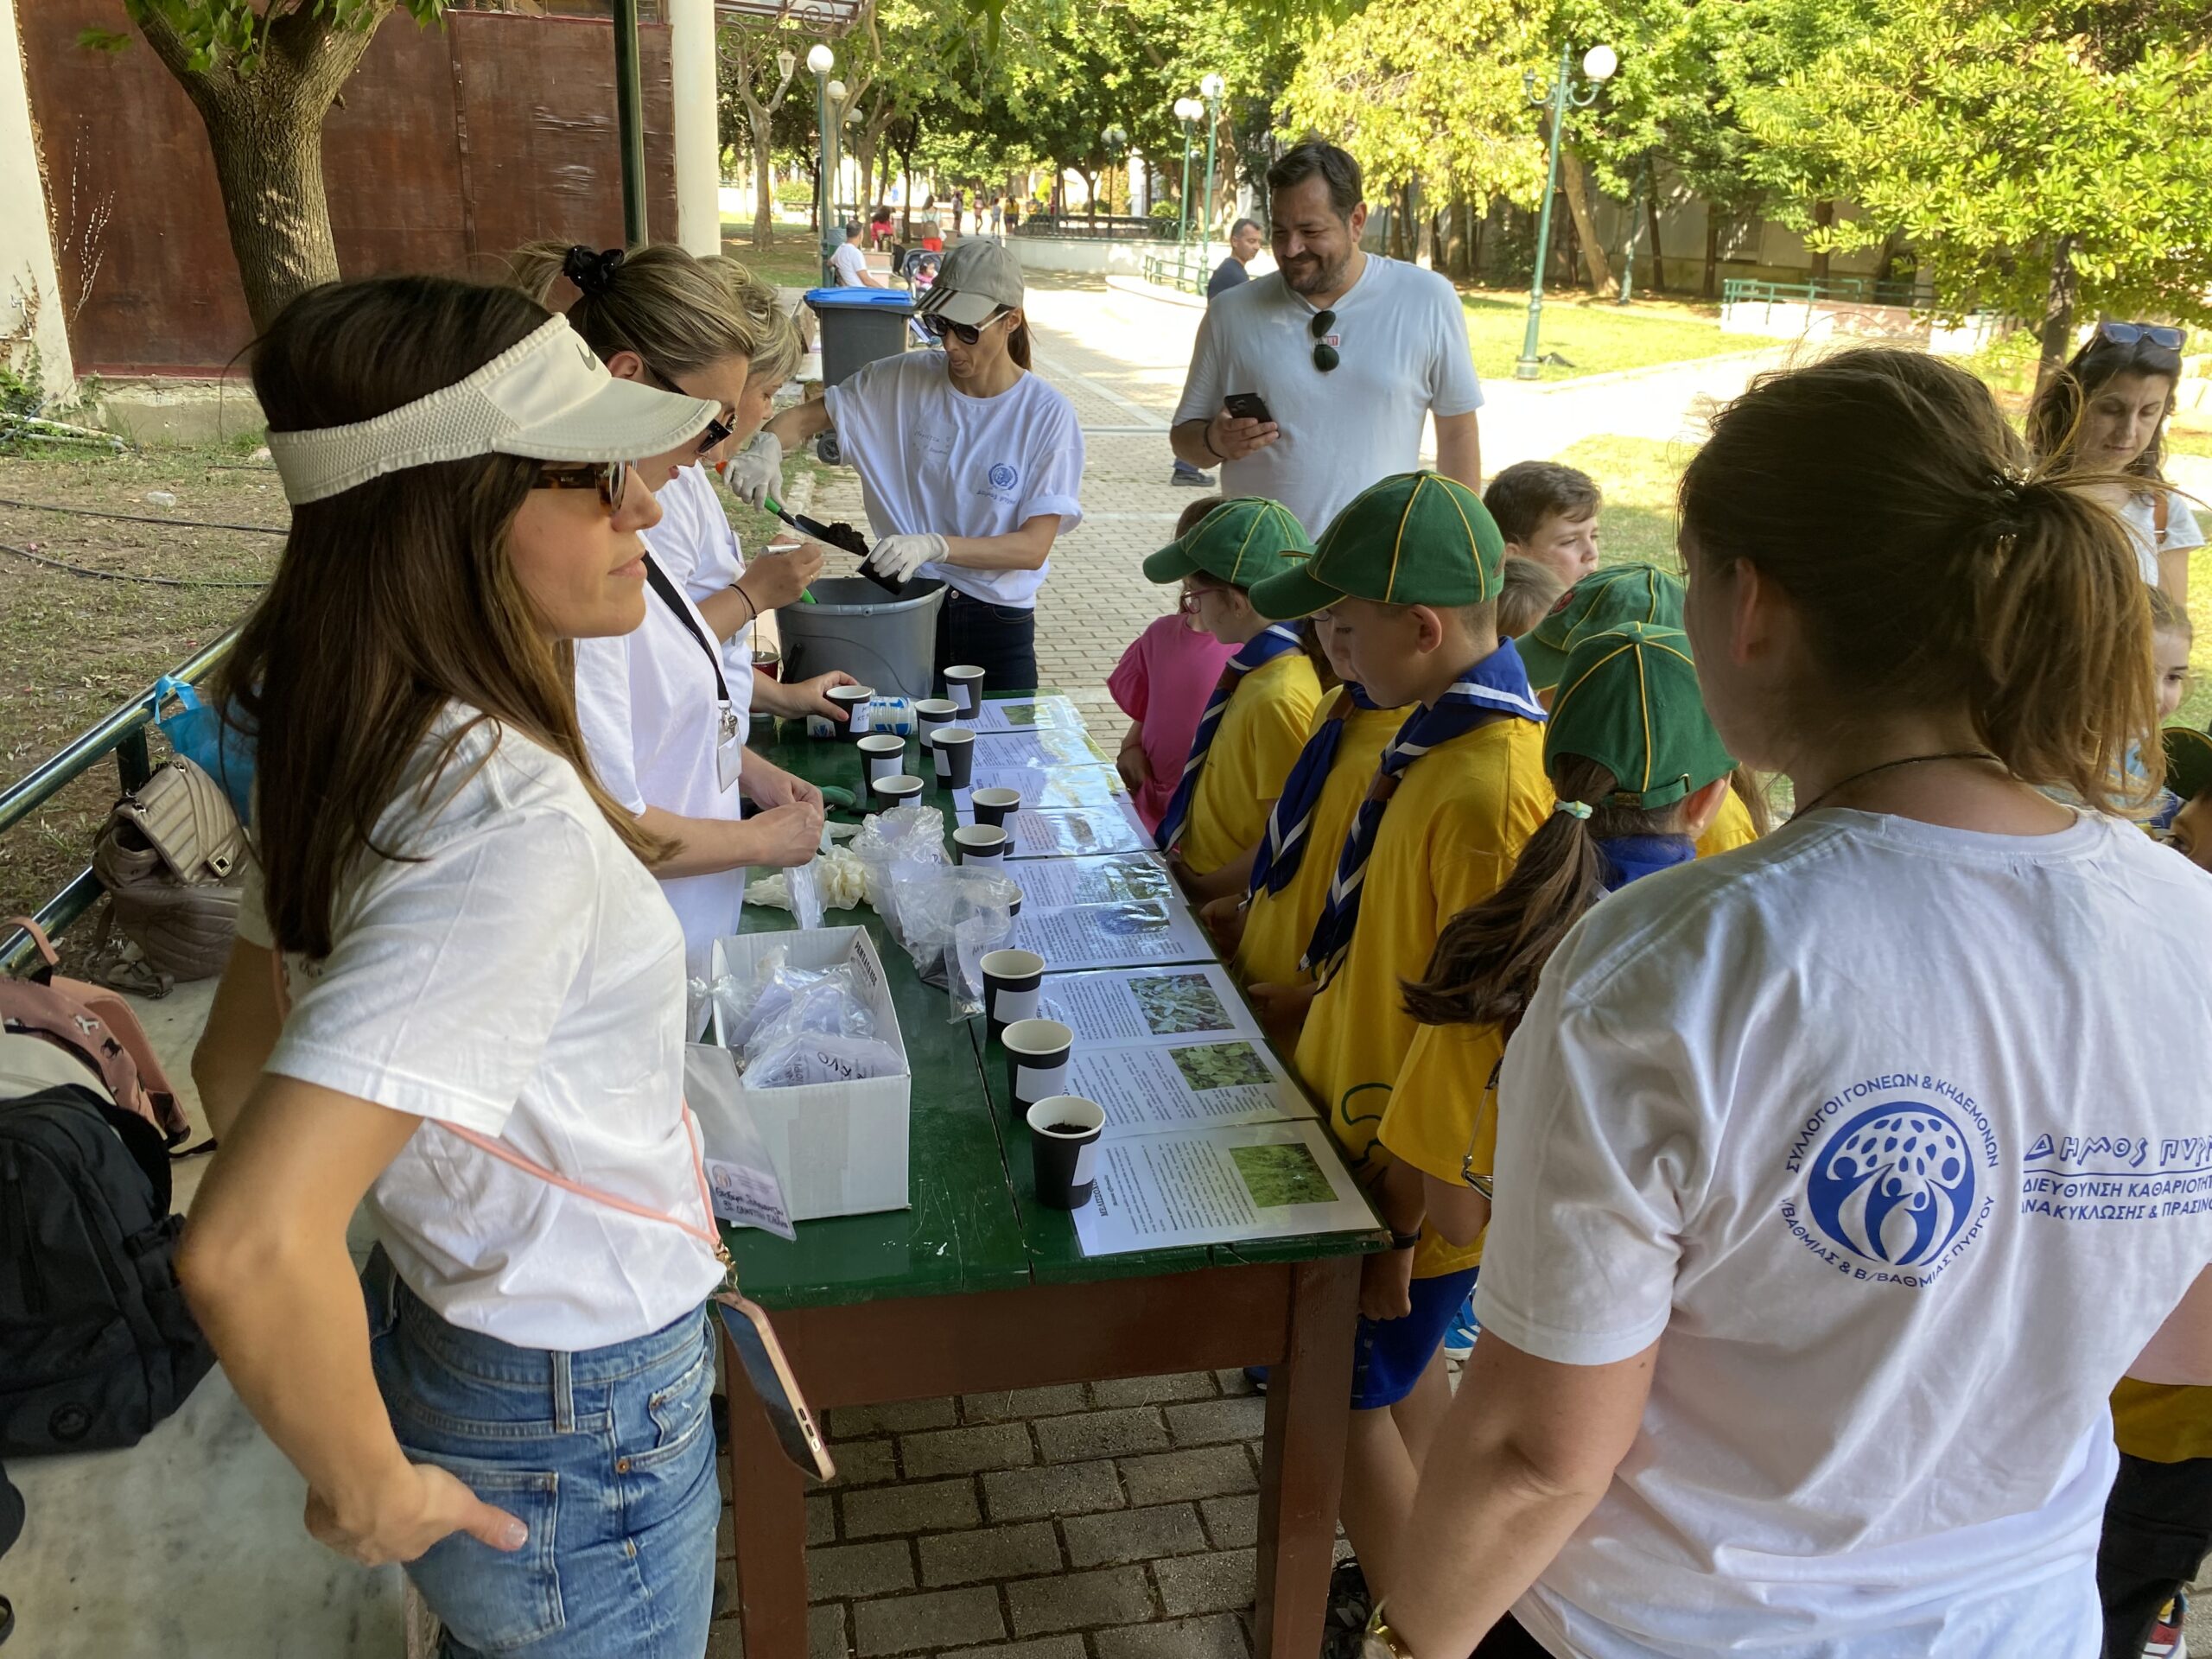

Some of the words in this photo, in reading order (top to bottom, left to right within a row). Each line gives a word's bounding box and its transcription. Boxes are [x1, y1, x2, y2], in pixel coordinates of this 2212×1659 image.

[1786, 1096, 1844, 1173] ΣΥΛΛΟΓΟΙ
[1843, 1074, 1918, 1103] ΓΟΝΕΩΝ
[1922, 1076, 1932, 1089] &
[1935, 1079, 1999, 1168] ΚΗΔΕΜΟΝΩΝ
[2023, 1178, 2123, 1198] ΔΙΕΥΘΥΝΣΗ
[2148, 1205, 2158, 1218] &
[1778, 1198, 1839, 1265] /ΒΑΘΜΙΑΣ
[1839, 1262, 1851, 1274] &
[1854, 1255, 1952, 1287] Β/ΒΑΘΜΙΑΣ
[1951, 1196, 1995, 1256] ΠΥΡΓΟΥ
